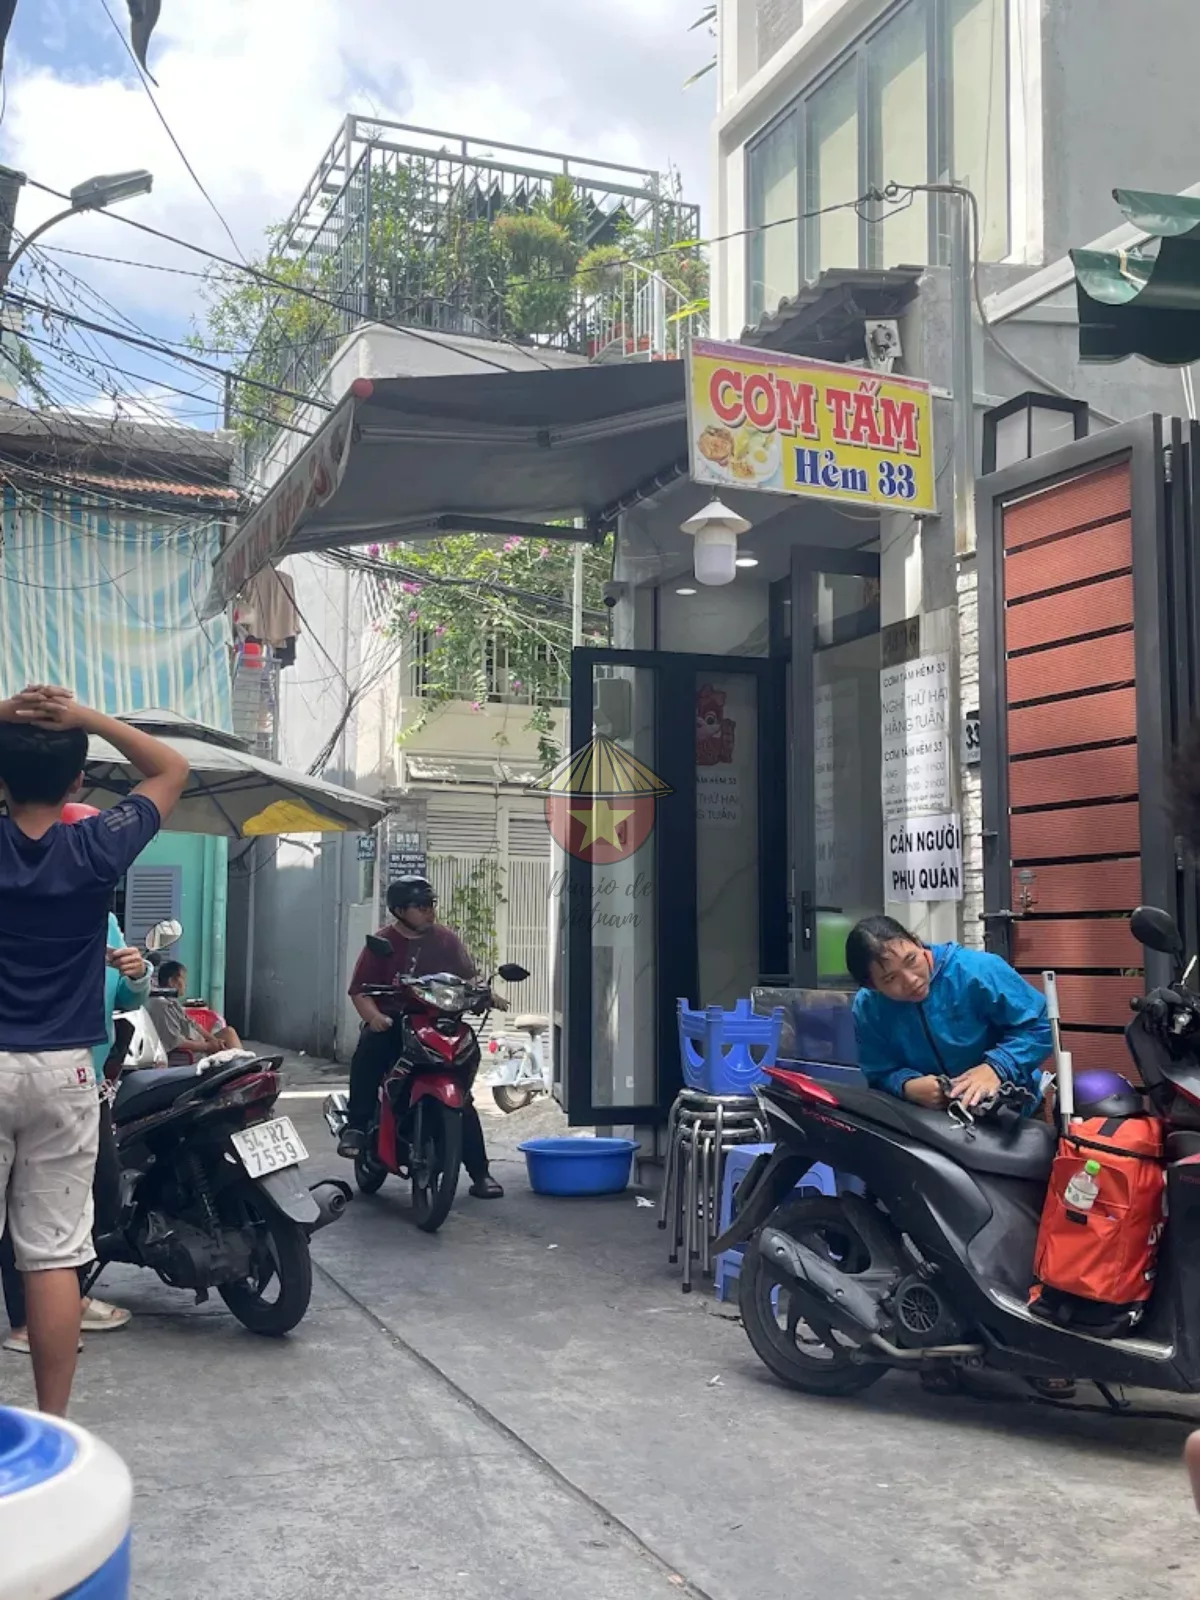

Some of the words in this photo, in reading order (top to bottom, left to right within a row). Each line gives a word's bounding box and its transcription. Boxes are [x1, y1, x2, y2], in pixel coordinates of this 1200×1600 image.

[710, 367, 818, 438] CƠM
[826, 381, 919, 454] TẤM
[794, 447, 868, 492] Hẻm
[878, 461, 915, 498] 33
[936, 662, 946, 674] 33
[934, 741, 944, 752] 33
[890, 824, 913, 854] CẦN
[917, 822, 960, 852] NGƯỜI
[892, 869, 915, 896] PHỤ
[919, 861, 959, 890] QUÁN
[250, 1140, 298, 1172] 7559
